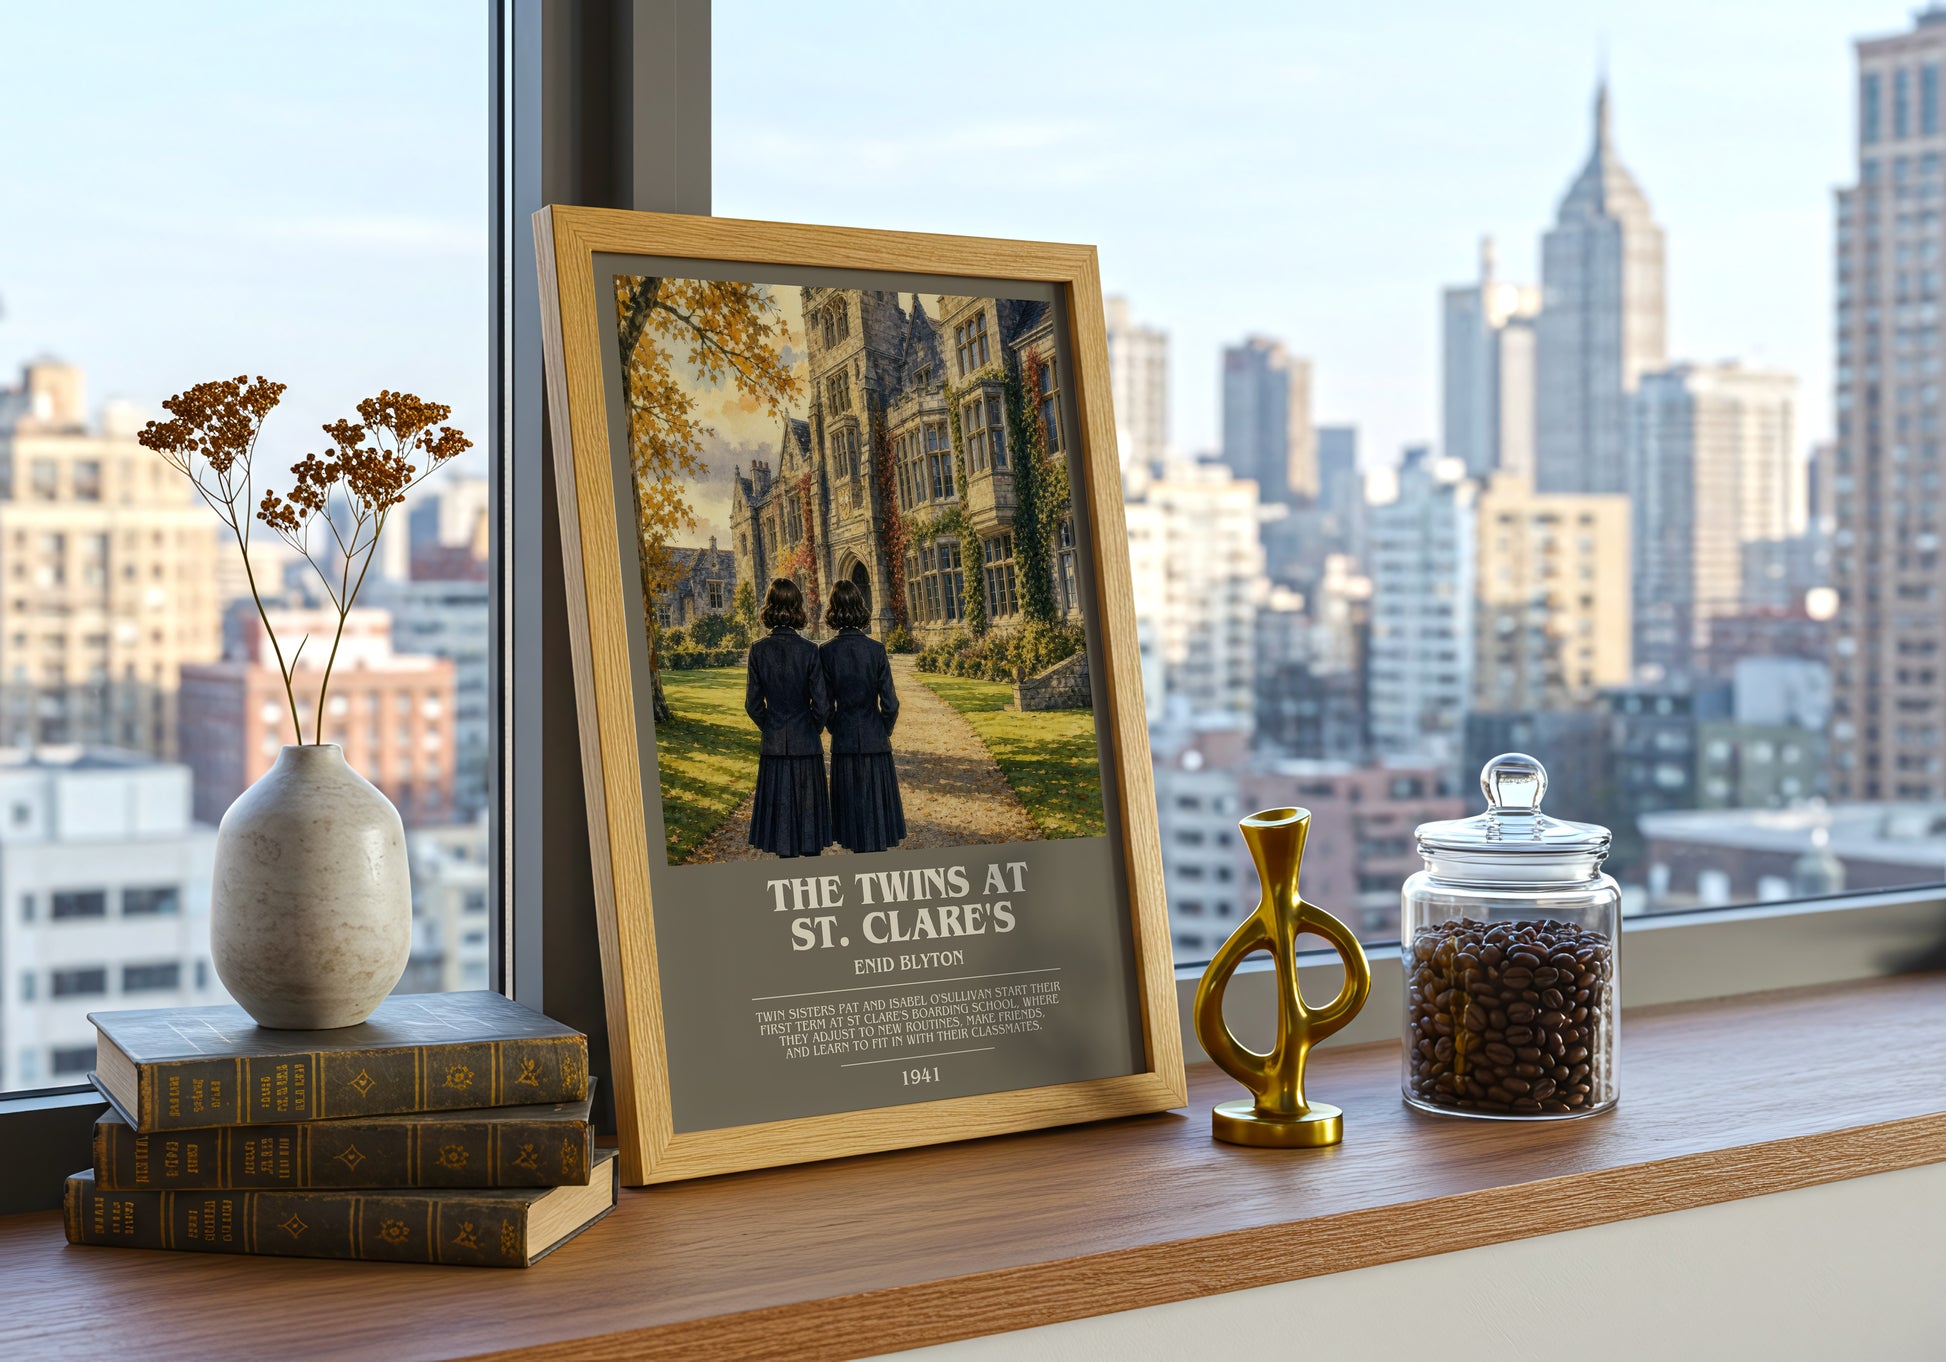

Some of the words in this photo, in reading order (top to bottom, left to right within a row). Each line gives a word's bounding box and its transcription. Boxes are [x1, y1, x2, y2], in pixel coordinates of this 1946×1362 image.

[767, 874, 844, 911] THE
[855, 866, 969, 904] TWINS
[983, 861, 1028, 895] AT
[791, 916, 849, 951] ST.
[862, 901, 1015, 944] CLARE'S
[854, 957, 894, 974] ENID
[900, 949, 964, 970] BLYTON
[756, 1010, 785, 1022] TWIN
[789, 1005, 835, 1020] SISTERS
[839, 1002, 859, 1014] PAT
[863, 1000, 885, 1012] AND
[889, 996, 927, 1009] ISABEL
[931, 988, 992, 1004] O'SULLIVAN
[995, 985, 1027, 998] START
[1030, 981, 1060, 994] THEIR
[760, 1022, 792, 1036] FIRST
[795, 1019, 826, 1032] TERM
[830, 1017, 843, 1028] AT
[847, 1015, 860, 1027] ST
[864, 1010, 909, 1024] CLARE'S
[912, 1004, 968, 1020] BOARDING
[972, 999, 1020, 1013] SCHOOL,
[1023, 994, 1060, 1007] WHERE
[779, 1033, 809, 1046] THEY
[813, 1028, 856, 1043] ADJUST
[858, 1026, 874, 1038] TO
[878, 1023, 902, 1036] NEW
[906, 1016, 963, 1033] ROUTINES,
[967, 1013, 996, 1026] MAKE
[999, 1008, 1045, 1022] FRIENDS,
[786, 1047, 810, 1059] AND
[814, 1042, 850, 1056] LEARN
[852, 1040, 868, 1051] TO
[872, 1037, 888, 1049] FIT
[892, 1036, 903, 1047] IN
[907, 1032, 934, 1046] WITH
[937, 1028, 969, 1042] THEIR
[971, 1020, 1042, 1038] CLASSMATES.
[902, 1066, 941, 1086] 1941
